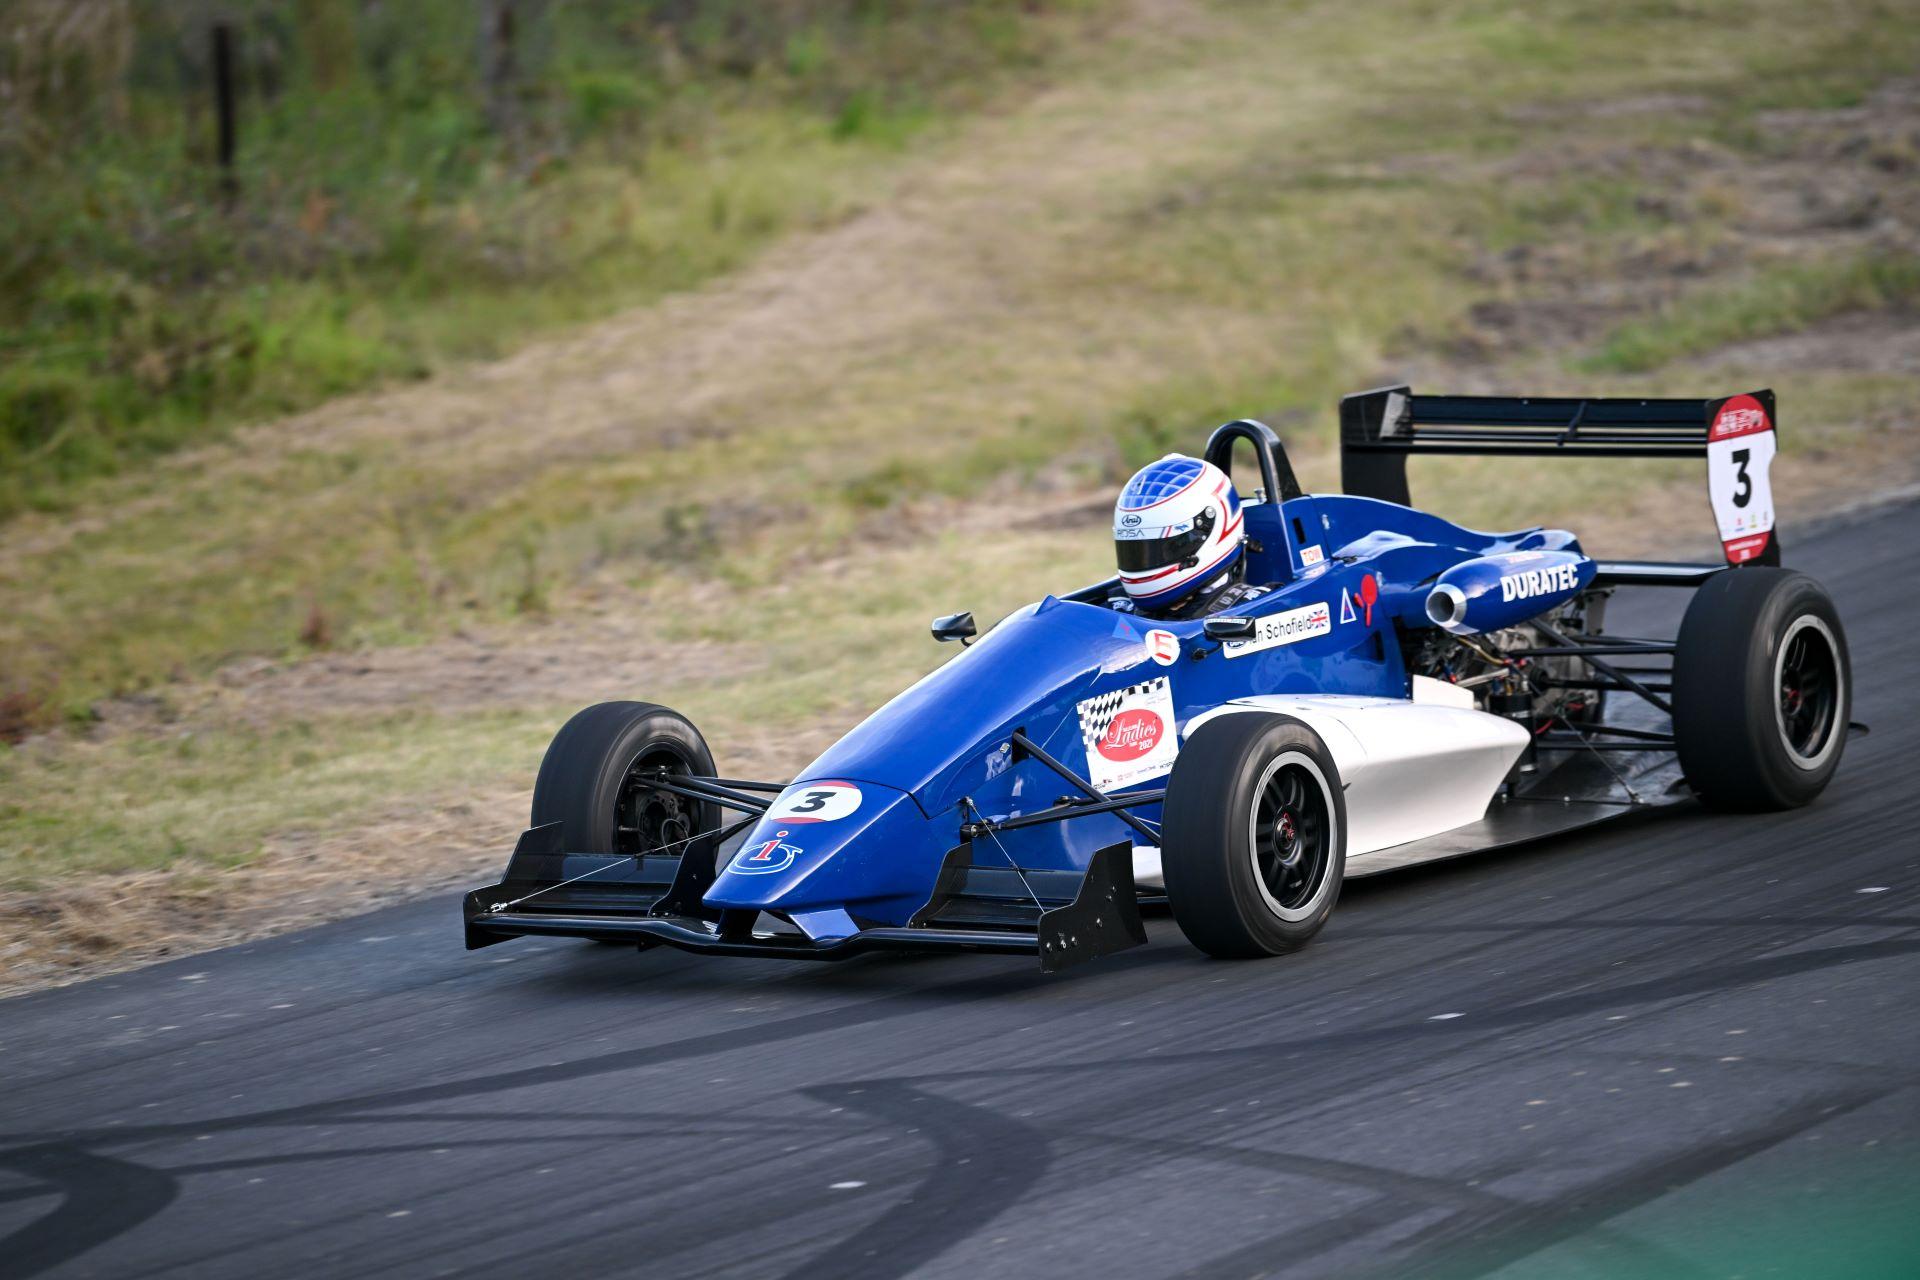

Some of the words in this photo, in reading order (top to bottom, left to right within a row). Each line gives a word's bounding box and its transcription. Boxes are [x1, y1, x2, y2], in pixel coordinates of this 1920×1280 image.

[1731, 448, 1752, 508] 3
[1500, 563, 1580, 602] DURATEC
[1266, 614, 1313, 639] Schofield
[1105, 718, 1157, 749] Ladies
[1139, 738, 1153, 750] 2021
[789, 791, 837, 813] 3
